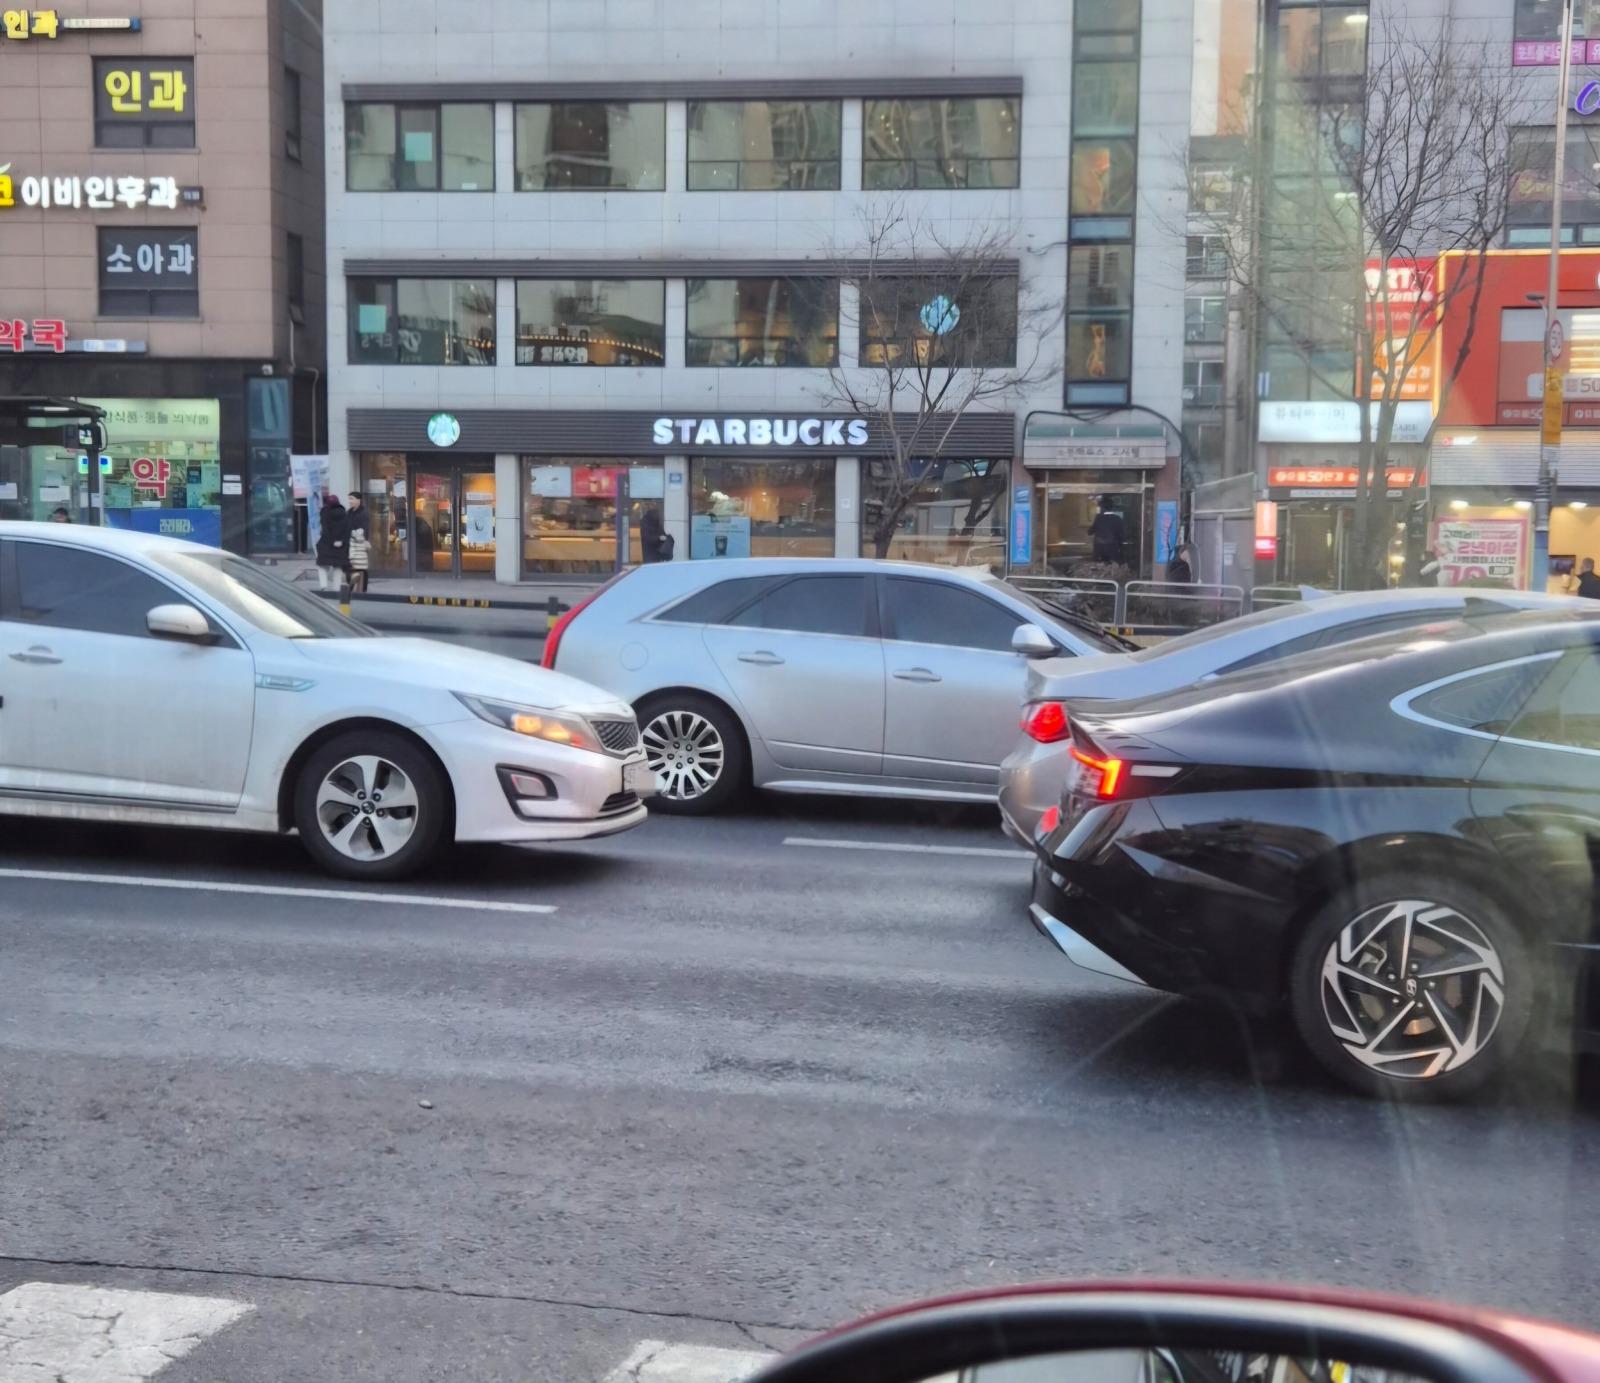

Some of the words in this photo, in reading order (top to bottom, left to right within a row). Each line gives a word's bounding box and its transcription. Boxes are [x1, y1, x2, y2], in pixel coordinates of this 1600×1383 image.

[105, 71, 187, 112] 인과
[21, 176, 179, 209] 이비인후과
[106, 244, 195, 274] 소아과
[653, 418, 868, 446] STARBUCKS
[132, 456, 171, 498] 약
